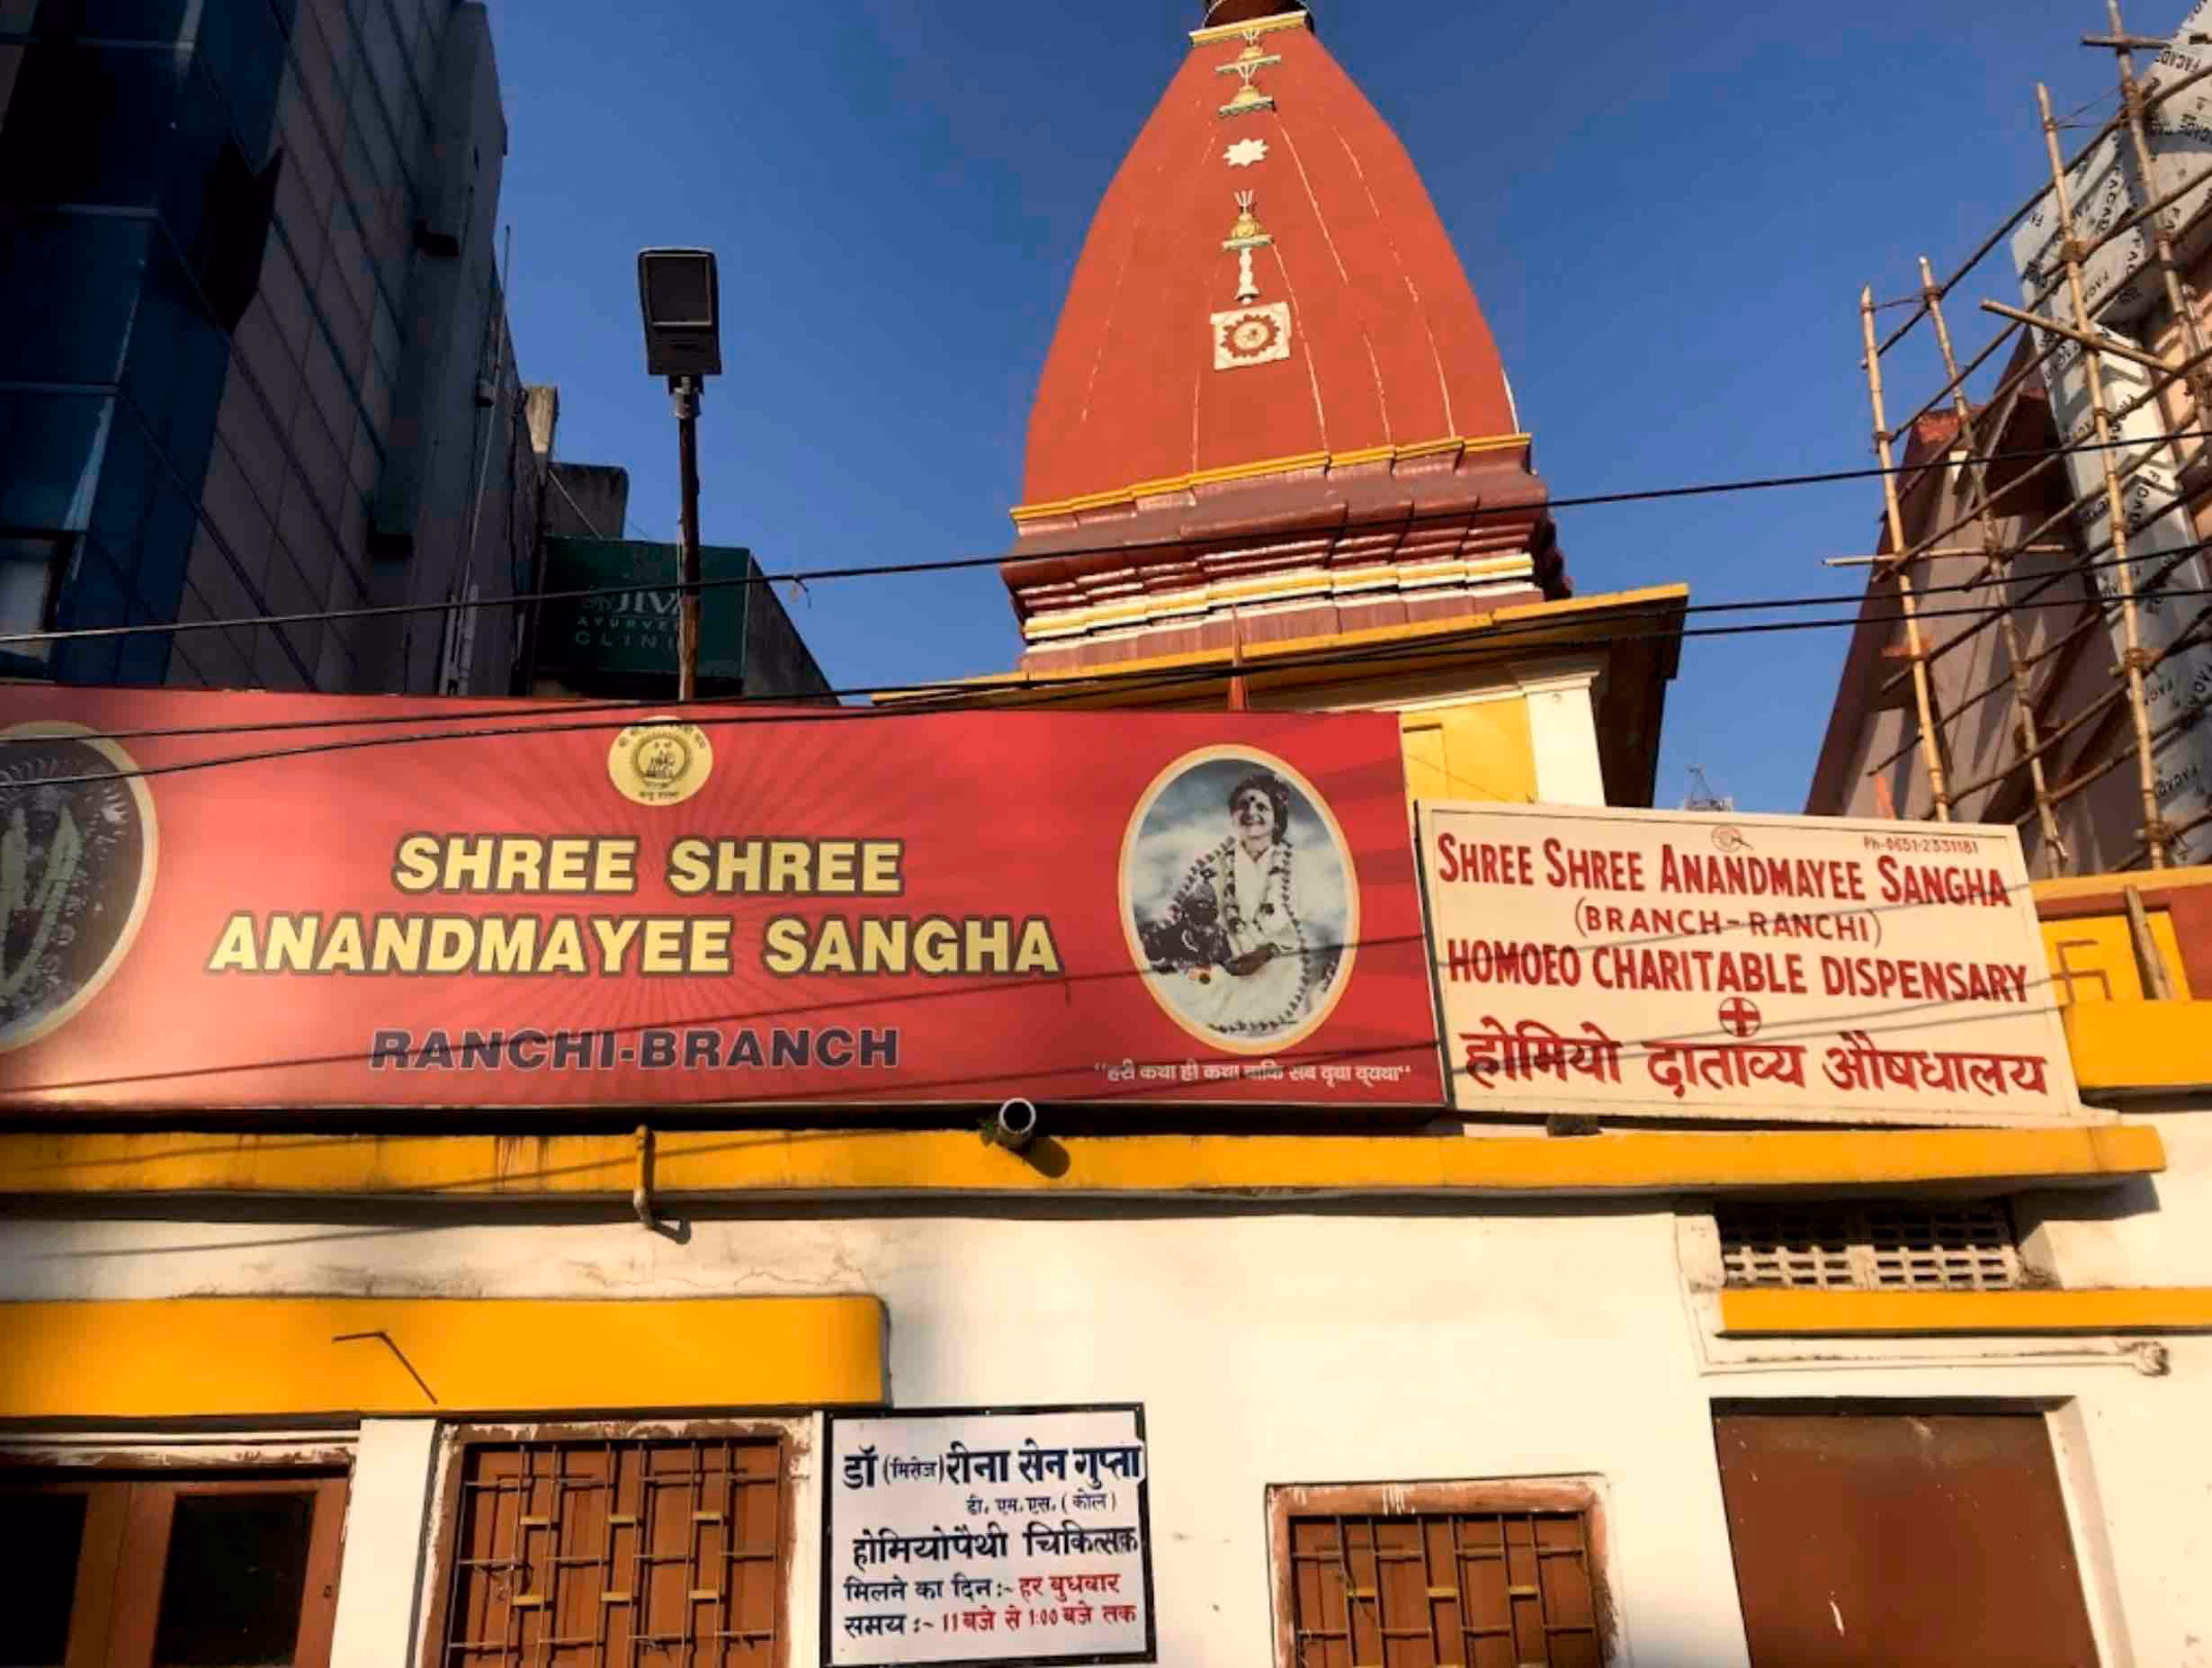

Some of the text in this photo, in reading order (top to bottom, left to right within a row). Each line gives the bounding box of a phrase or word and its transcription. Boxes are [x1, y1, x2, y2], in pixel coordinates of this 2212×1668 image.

[574, 631, 679, 649] CLINI
[394, 836, 903, 894] SHREE SHREE
[1437, 832, 2012, 907] SHREE SHREE ANANDMAYEE SANGHA
[208, 914, 1061, 973] ANANDMAYEE SANGHA
[1448, 938, 2028, 1003] HOMOEO CHARITABLE DISPENSARY
[368, 1027, 900, 1072] RANCHI-BRANCH
[1460, 1015, 1622, 1090] होमियो
[1822, 1028, 2048, 1096] औषधालय
[843, 1444, 878, 1491] डॉ
[945, 1440, 1010, 1484] रीना
[1018, 1438, 1069, 1484] सेन
[1072, 1445, 1142, 1490] गुप्ता
[853, 1520, 1139, 1572] होमियोपैथी चिकित्सक
[844, 1574, 909, 1603] मिलने
[915, 1577, 944, 1601] का
[1018, 1576, 1043, 1601] हर
[1049, 1573, 1122, 1603] बुधवार
[1005, 1604, 1022, 1631] से
[1103, 1603, 1138, 1624] तक
